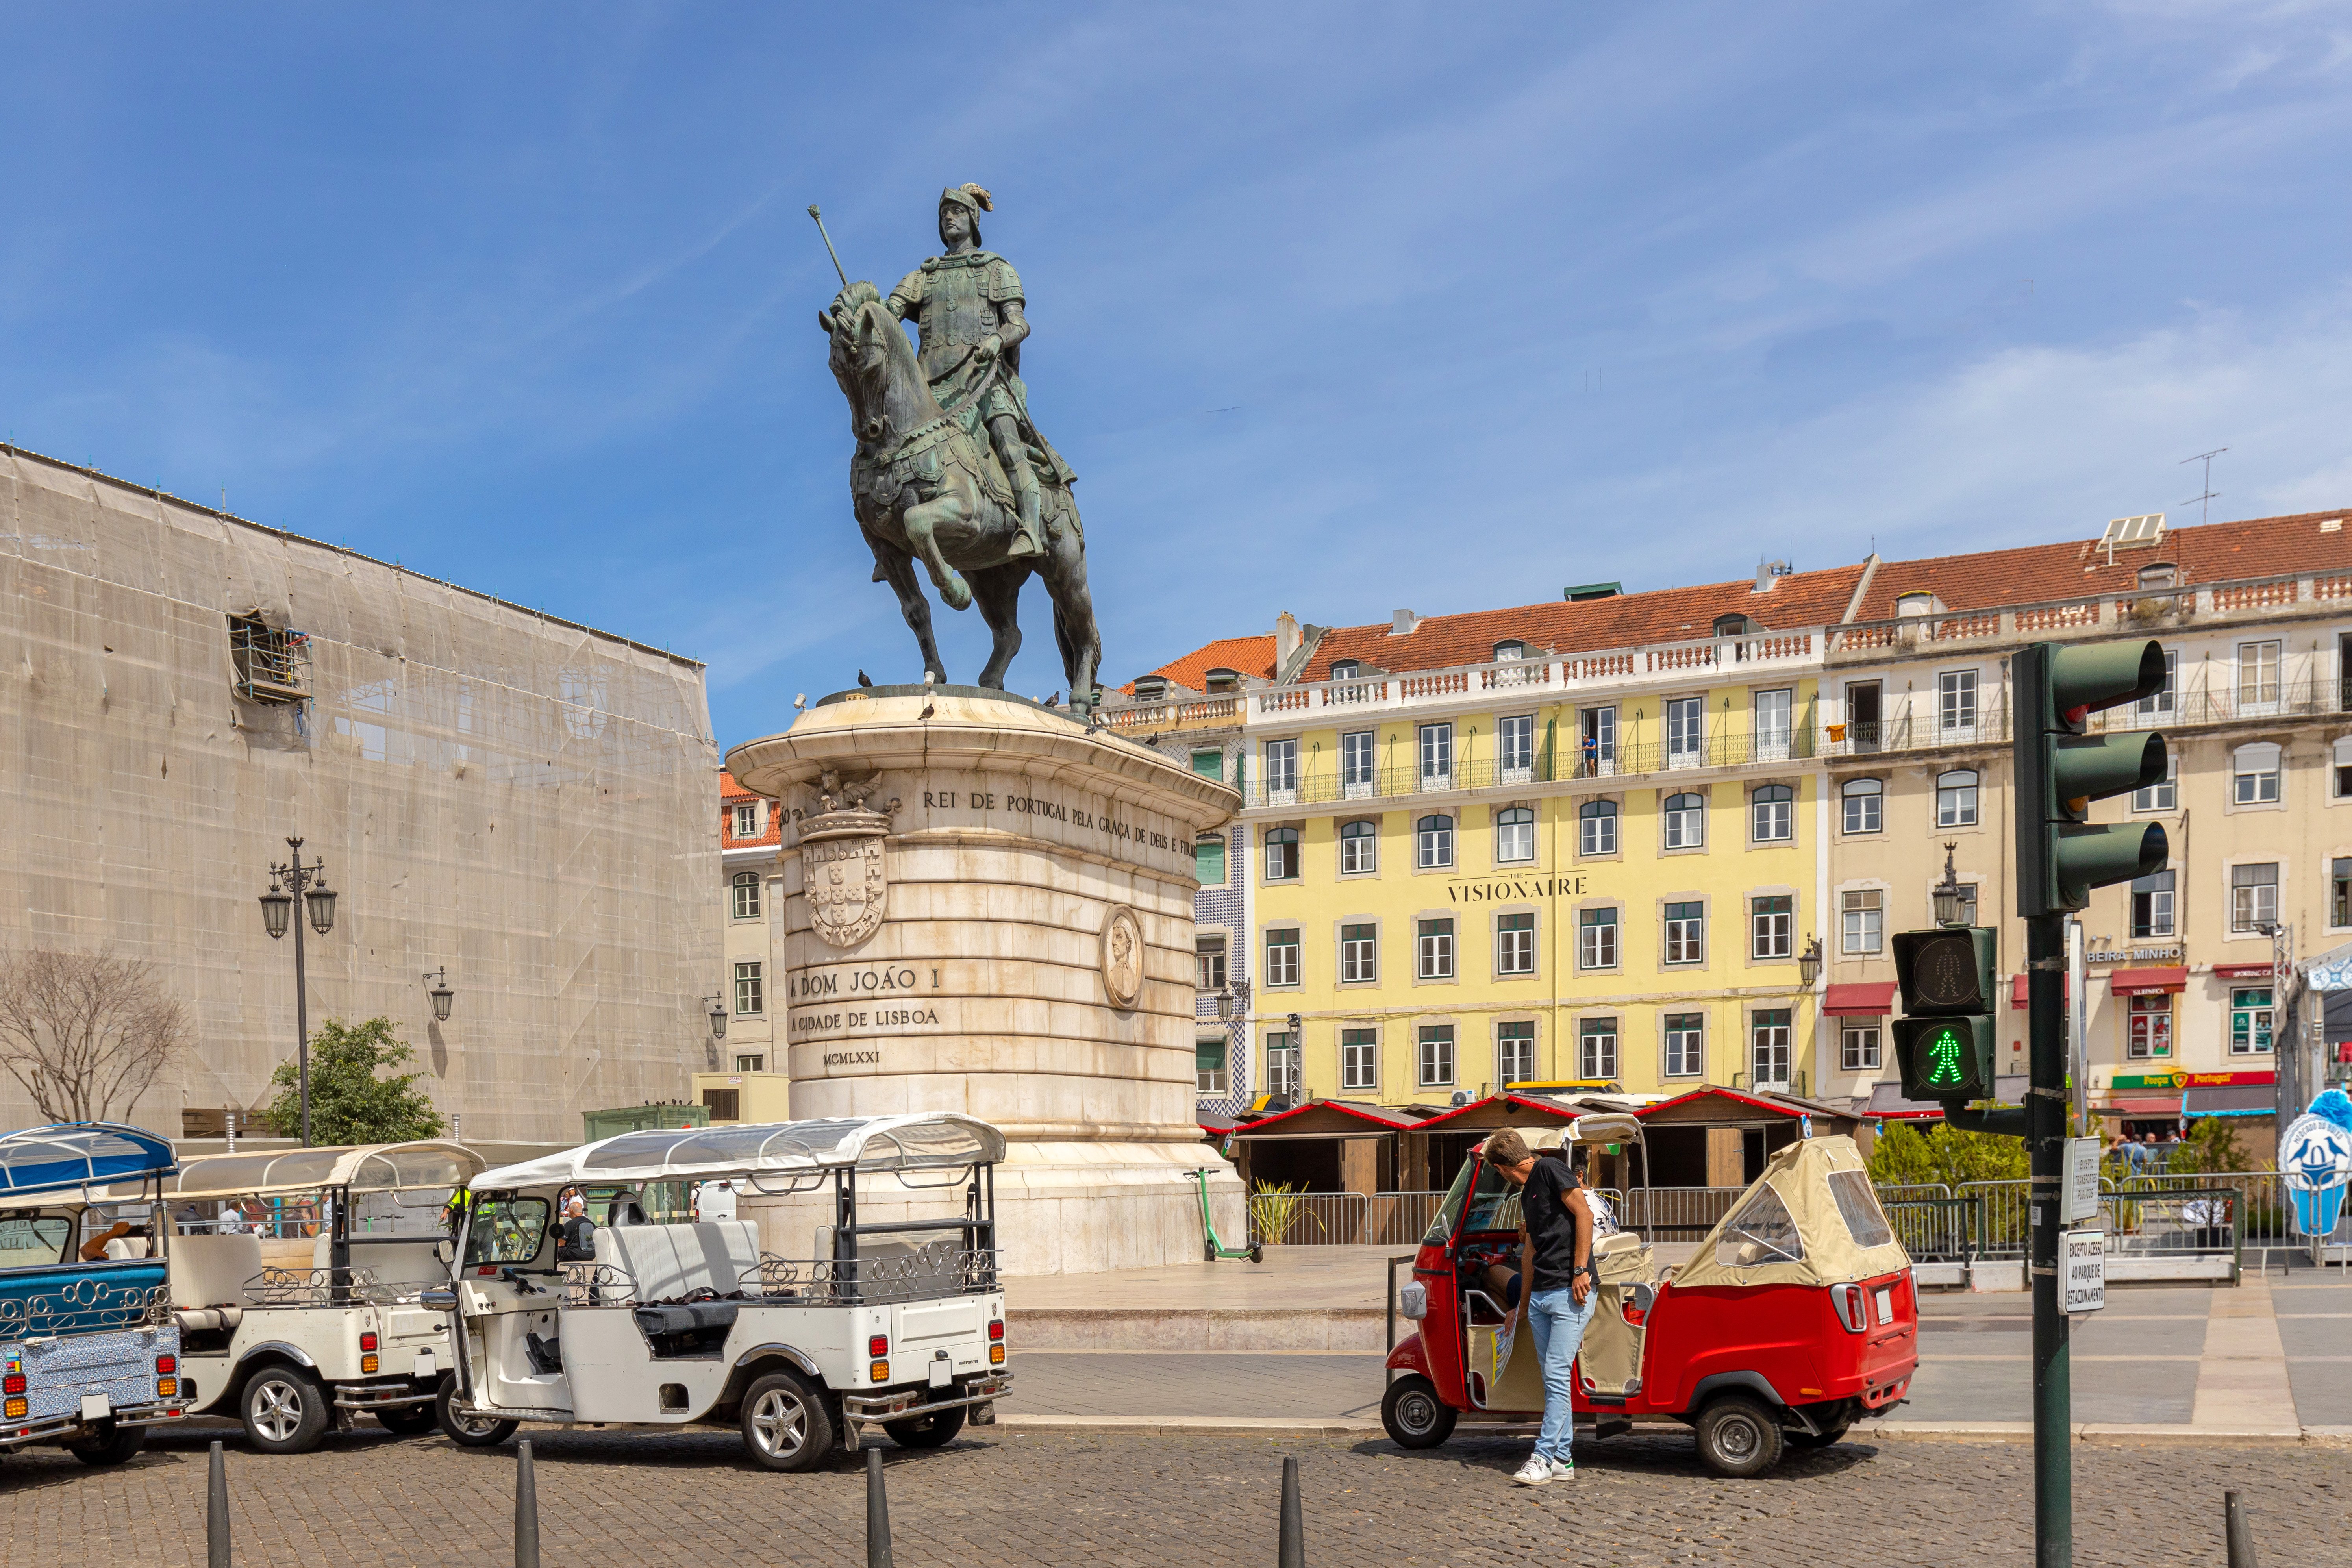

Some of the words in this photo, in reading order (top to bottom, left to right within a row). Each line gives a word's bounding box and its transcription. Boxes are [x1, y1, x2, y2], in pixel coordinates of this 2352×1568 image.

[923, 792, 955, 808] REI
[971, 793, 994, 809] DE
[1007, 795, 1068, 822] PORTUGAL
[1072, 809, 1093, 829] PELA
[1099, 817, 1130, 840] GRAÇA
[1135, 828, 1145, 843] DE
[1150, 831, 1167, 850] DEUS
[1172, 837, 1176, 852] E
[1448, 877, 1587, 903] VISIONAIRE
[2087, 950, 2127, 962] BEIRA
[2133, 947, 2181, 960] MINHO
[791, 979, 796, 997] A
[802, 974, 838, 996] DOM
[850, 966, 916, 990] JOÃO
[932, 969, 939, 988] I
[792, 1017, 797, 1031] A
[799, 1014, 841, 1031] CIDADE
[848, 1012, 867, 1028] DE
[876, 1009, 939, 1026] LISBOA
[824, 1052, 880, 1065] MCMLXXI
[2143, 1075, 2169, 1087] Força
[2194, 1074, 2232, 1085] Portugal
[2080, 1159, 2094, 1170] EXCEPTO
[2075, 1173, 2097, 1185] TRANSPORTES
[2069, 1242, 2087, 1258] EXCEPTO
[2088, 1241, 2103, 1257] ACESSO
[2072, 1266, 2078, 1280] AO
[2079, 1264, 2094, 1283] PARQUE
[2095, 1264, 2100, 1278] DE
[2067, 1287, 2104, 1305] ESTACIONAMENTO
